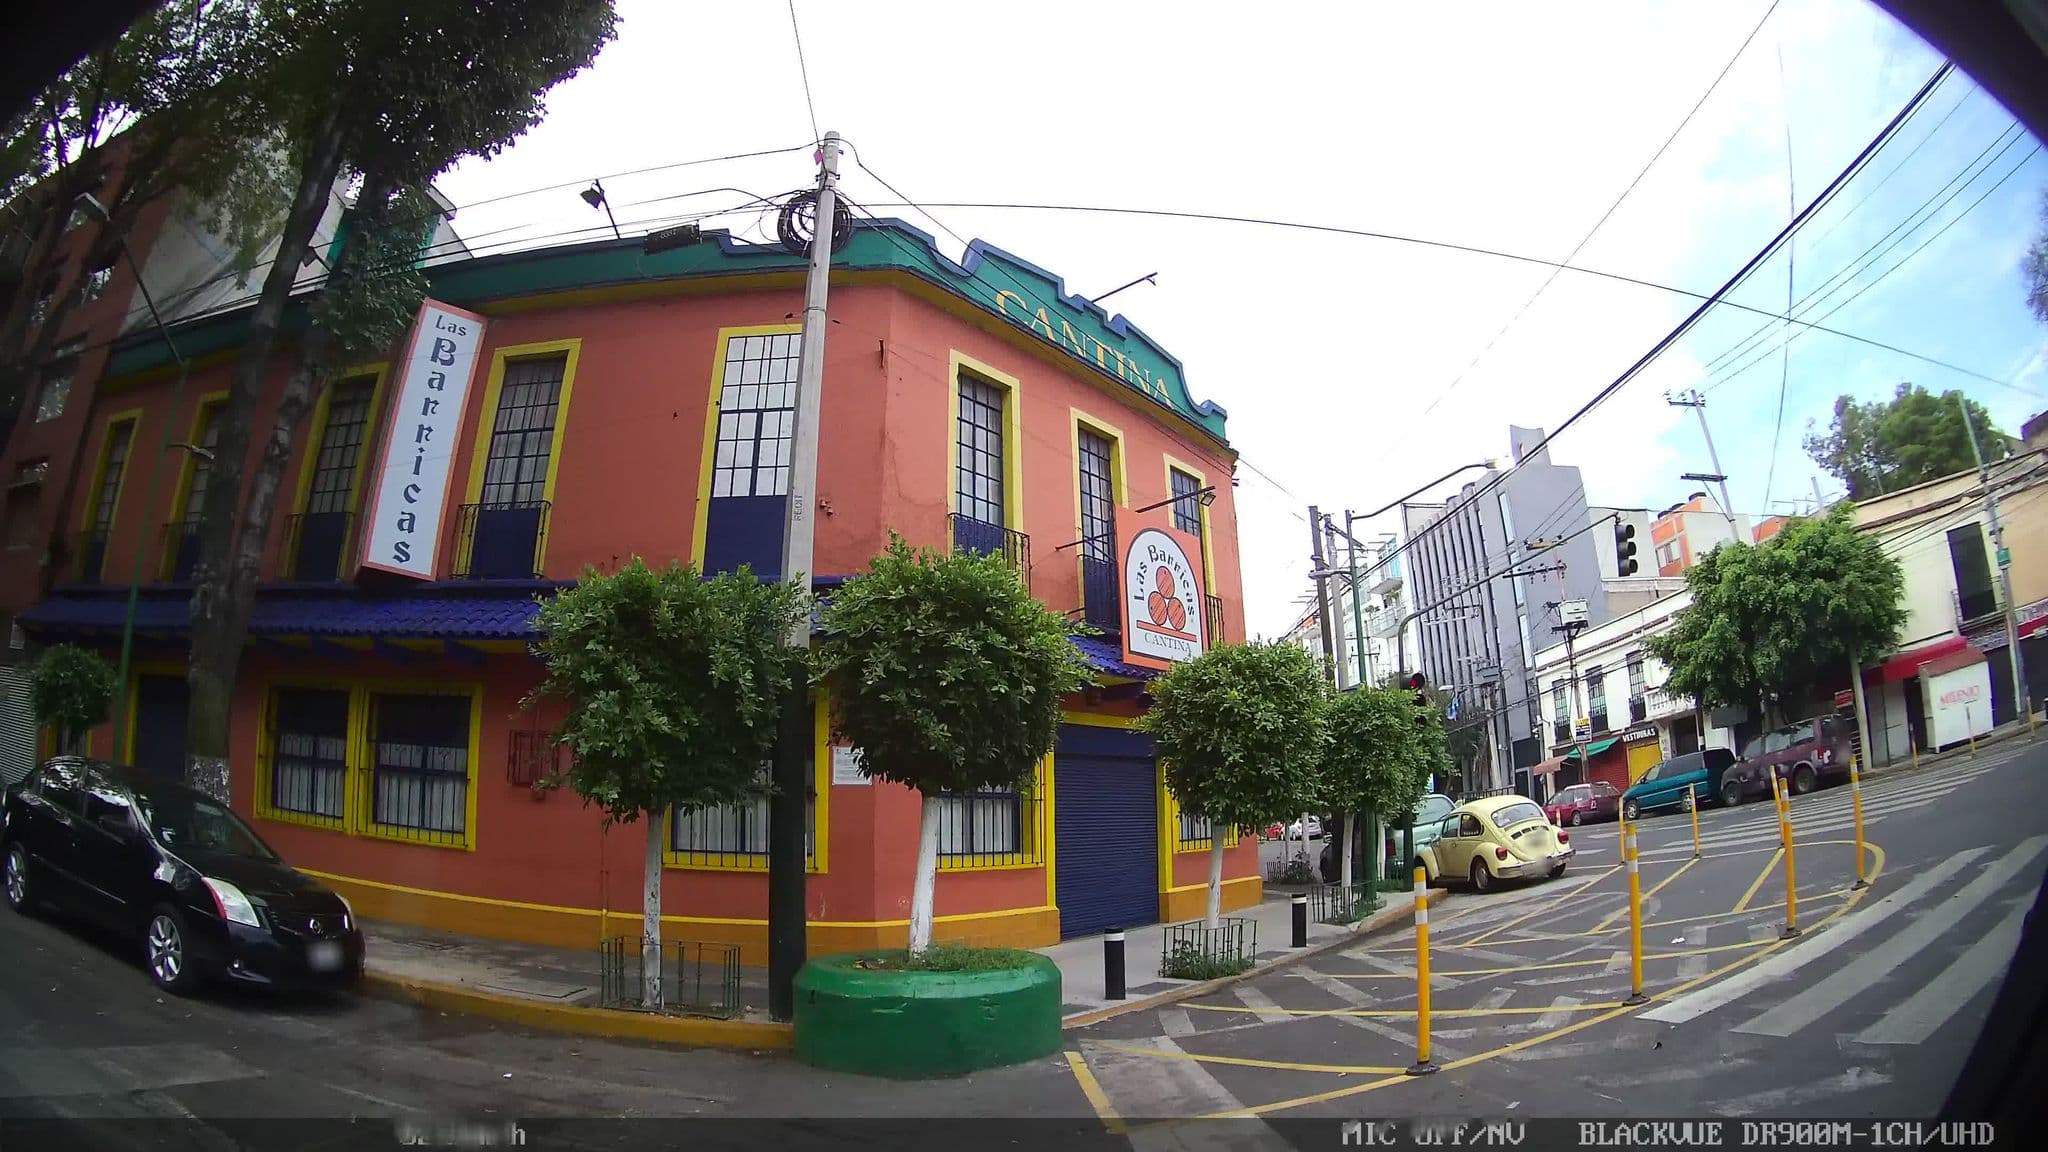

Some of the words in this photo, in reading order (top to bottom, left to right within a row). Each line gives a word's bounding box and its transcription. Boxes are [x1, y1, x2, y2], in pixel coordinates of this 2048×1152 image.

[436, 315, 467, 336] Las
[996, 290, 1173, 410] CANTINA
[393, 337, 456, 563] Barricas
[1134, 561, 1148, 602] Las
[1147, 544, 1195, 616] Barricas
[1144, 634, 1192, 655] CANTINA
